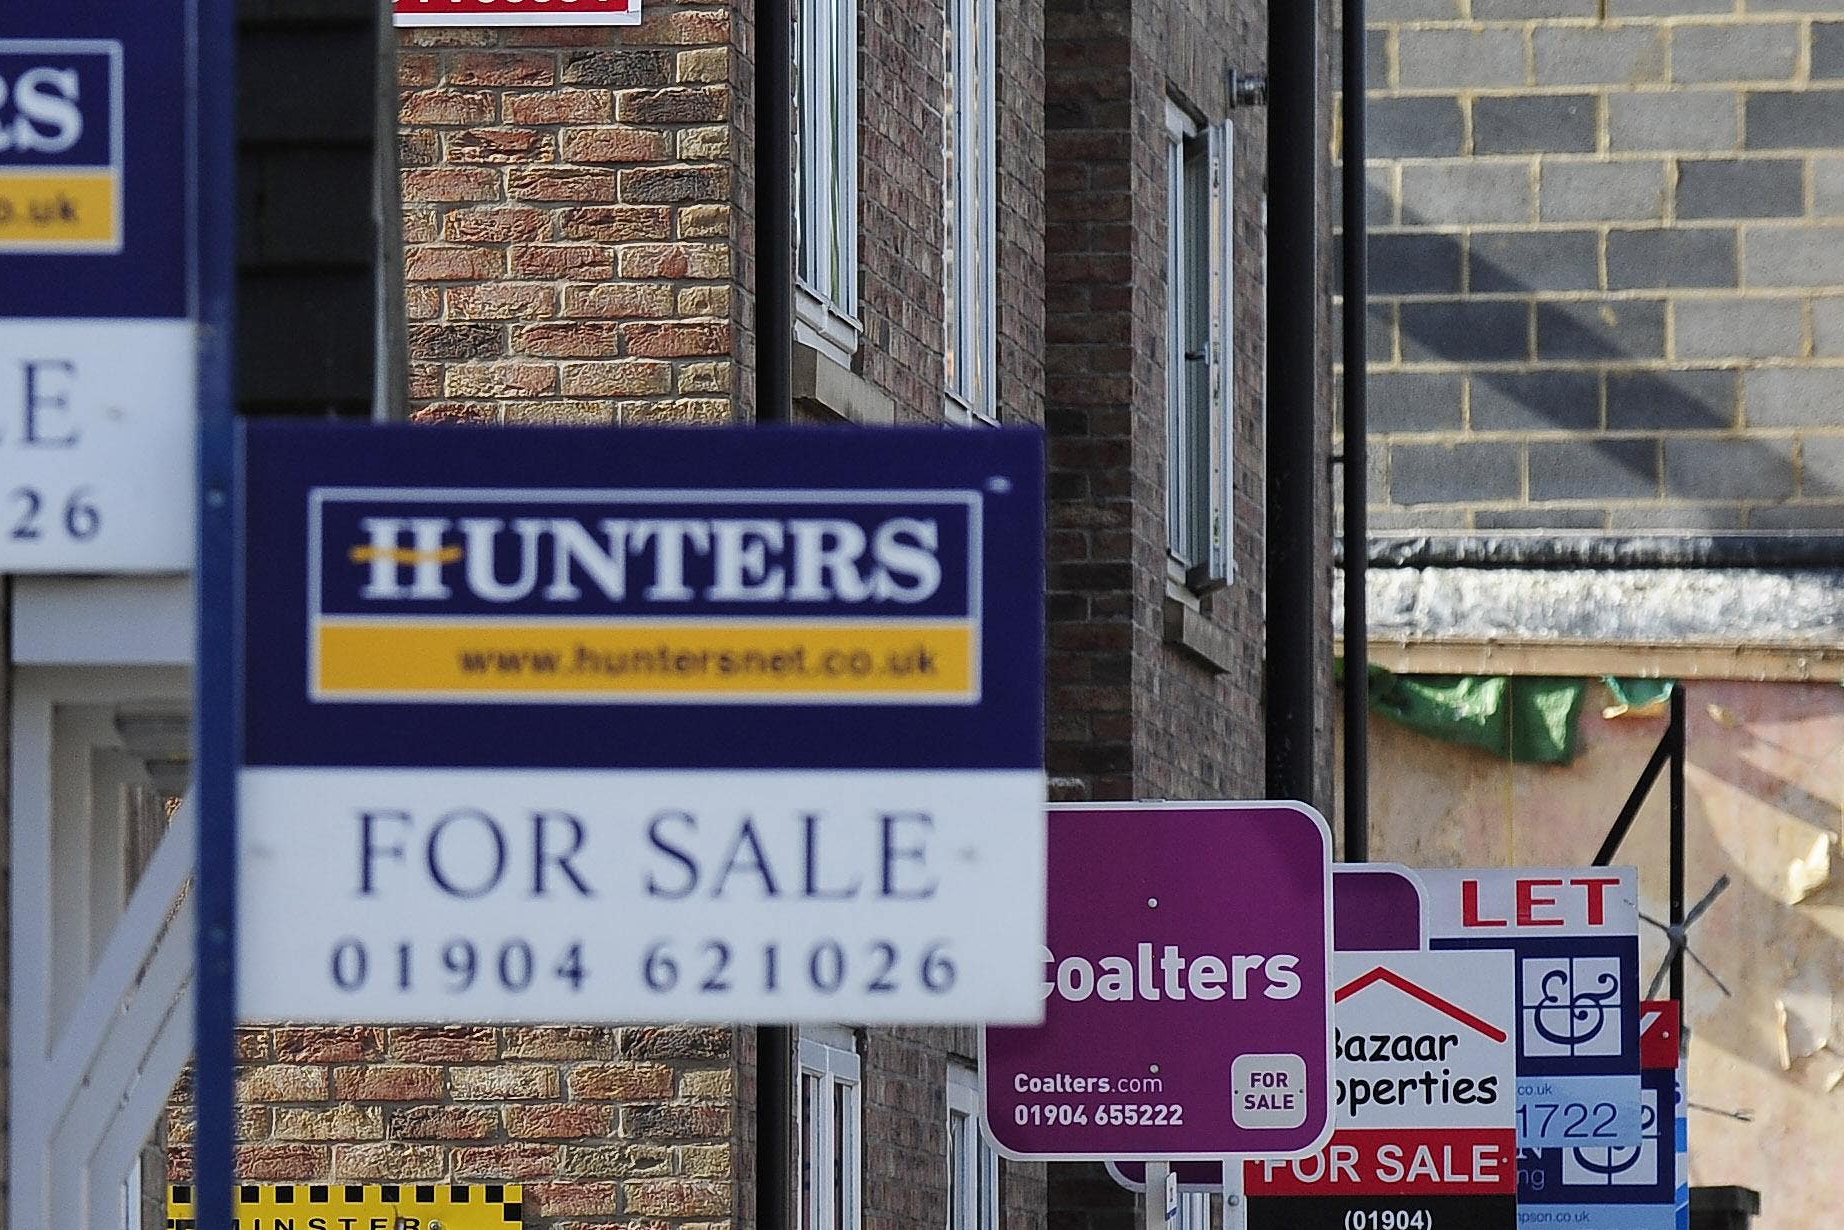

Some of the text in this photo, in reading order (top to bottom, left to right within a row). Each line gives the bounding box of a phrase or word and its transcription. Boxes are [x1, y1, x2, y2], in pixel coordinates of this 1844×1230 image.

[350, 517, 944, 602] HUNTERS
[459, 643, 939, 680] www.huntersnet.co.uk
[357, 807, 942, 902] FOR SALE
[1462, 879, 1620, 927] LET
[330, 937, 958, 992] 01904 621026
[1014, 1074, 1163, 1093] Coalters.com
[1250, 1072, 1288, 1088] FOR
[1336, 1069, 1498, 1116] perties
[1517, 1083, 1553, 1096] co.uk
[1014, 1104, 1183, 1126] 01904 655222
[1244, 1094, 1294, 1110] SALE
[1516, 1103, 1618, 1138] 1722
[1264, 1145, 1500, 1182] FOR SALE
[1517, 1211, 1590, 1224] pson.co.uk
